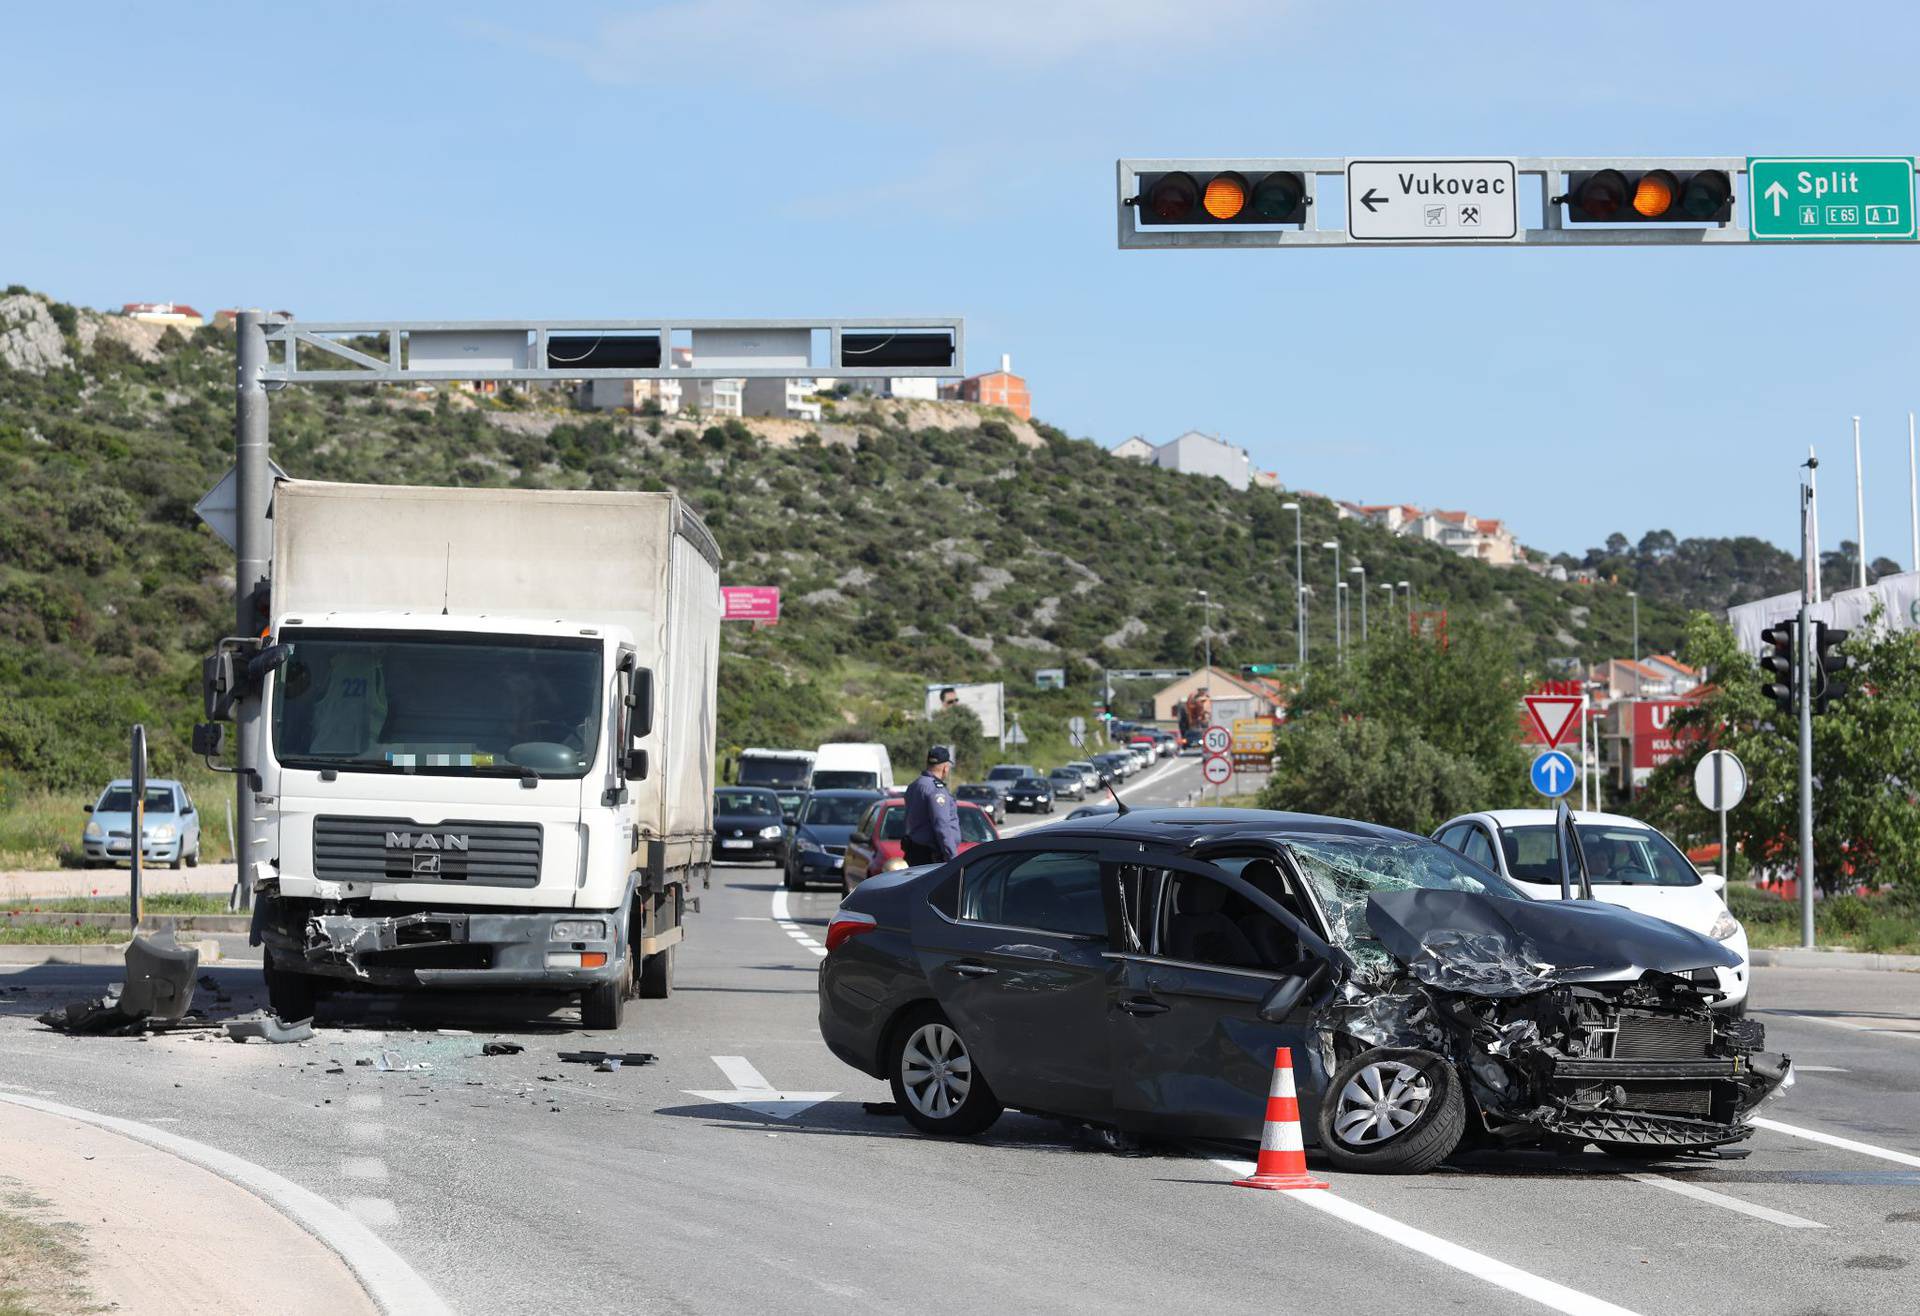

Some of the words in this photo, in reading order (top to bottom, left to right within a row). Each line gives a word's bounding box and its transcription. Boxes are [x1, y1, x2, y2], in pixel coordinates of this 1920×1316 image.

[1398, 172, 1505, 195] Vukovac
[1797, 171, 1859, 199] Split
[1830, 209, 1837, 222] E
[1840, 209, 1855, 222] 65
[1872, 209, 1880, 222] A
[1208, 732, 1226, 748] 50
[385, 831, 469, 851] MAN
